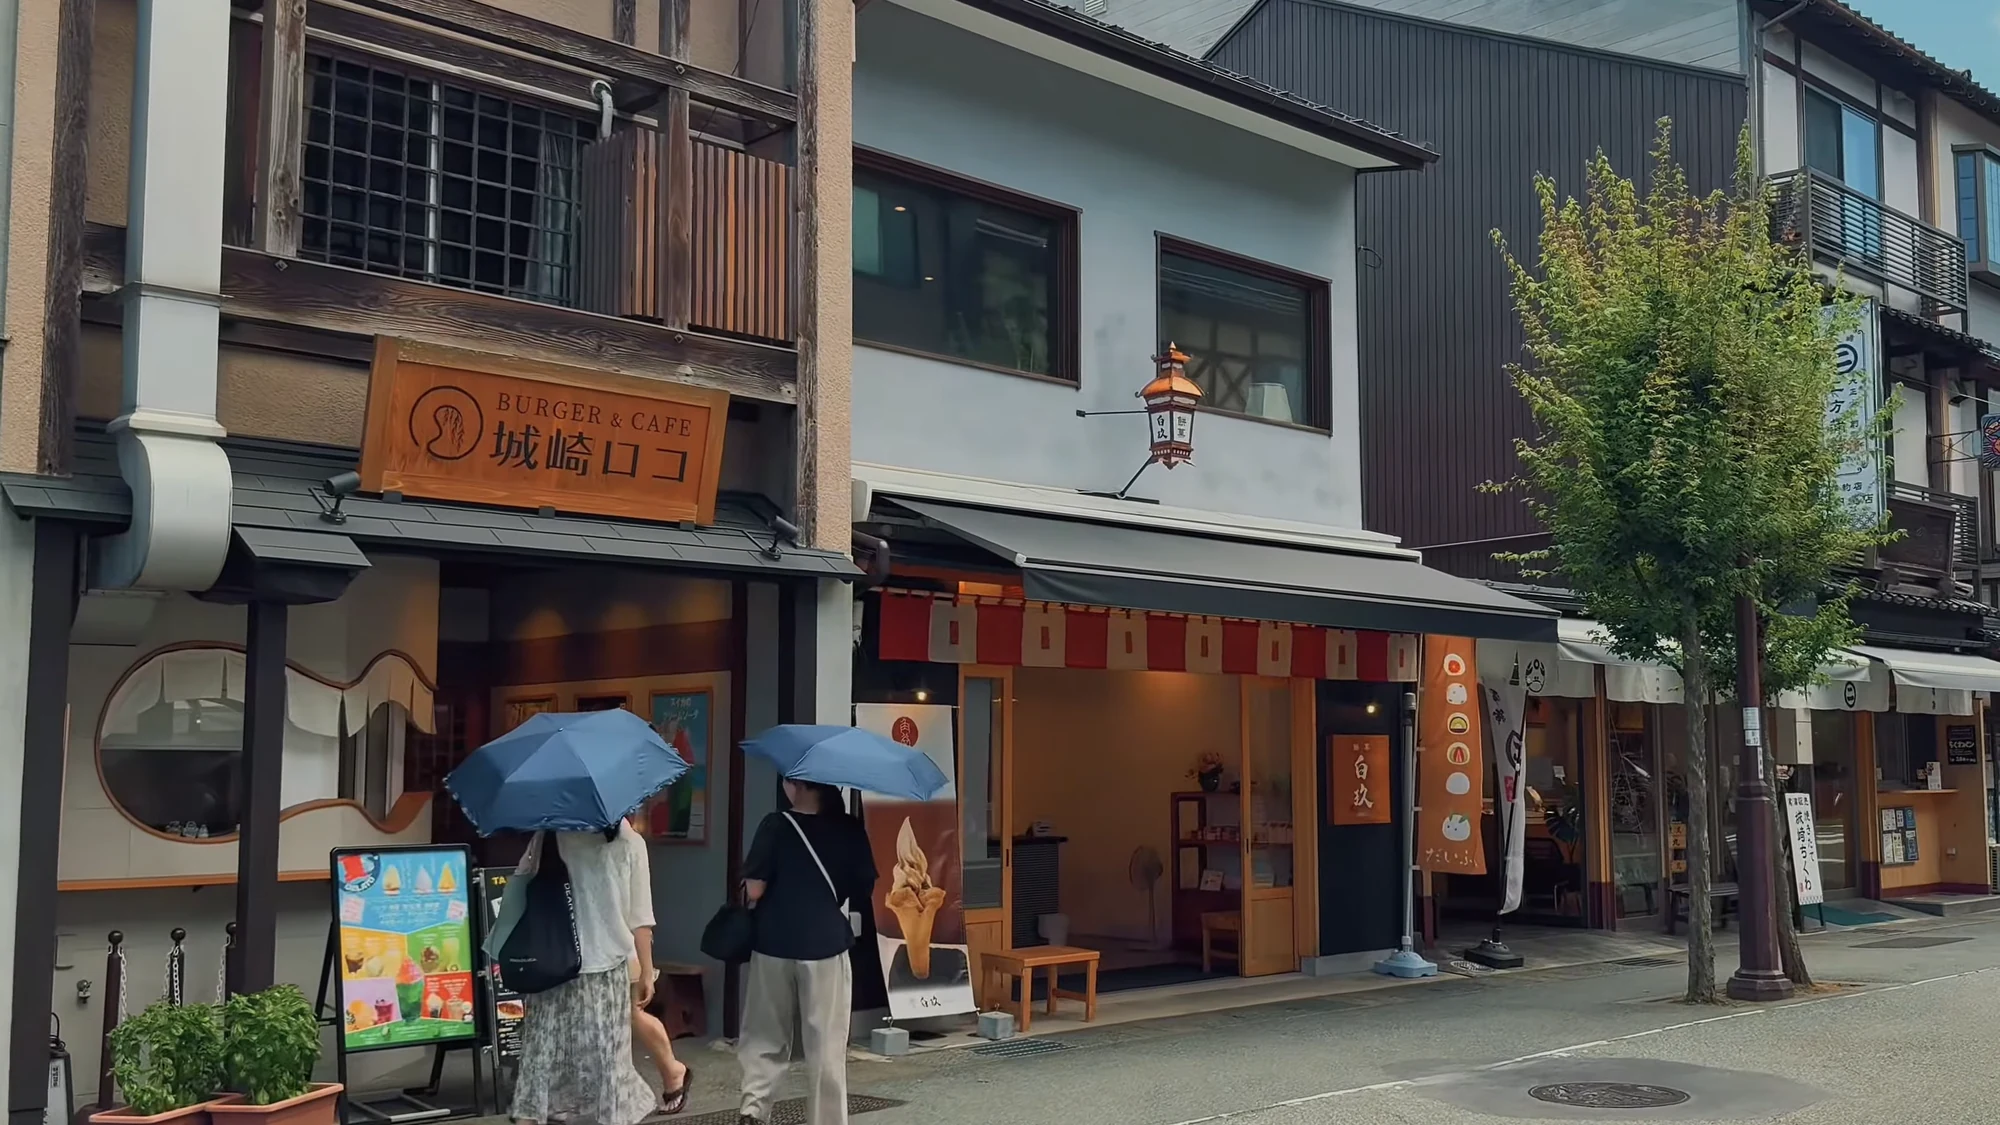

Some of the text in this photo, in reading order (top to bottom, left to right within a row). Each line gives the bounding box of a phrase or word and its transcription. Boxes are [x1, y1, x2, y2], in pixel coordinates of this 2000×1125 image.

[496, 392, 692, 437] BURGER & CAFE
[1156, 414, 1168, 440] 白玖
[489, 420, 688, 483] 城崎ロコ
[1353, 754, 1374, 809] 白玖
[1425, 847, 1478, 868] だいふく
[344, 876, 376, 892] GELATO
[491, 876, 507, 886] TA
